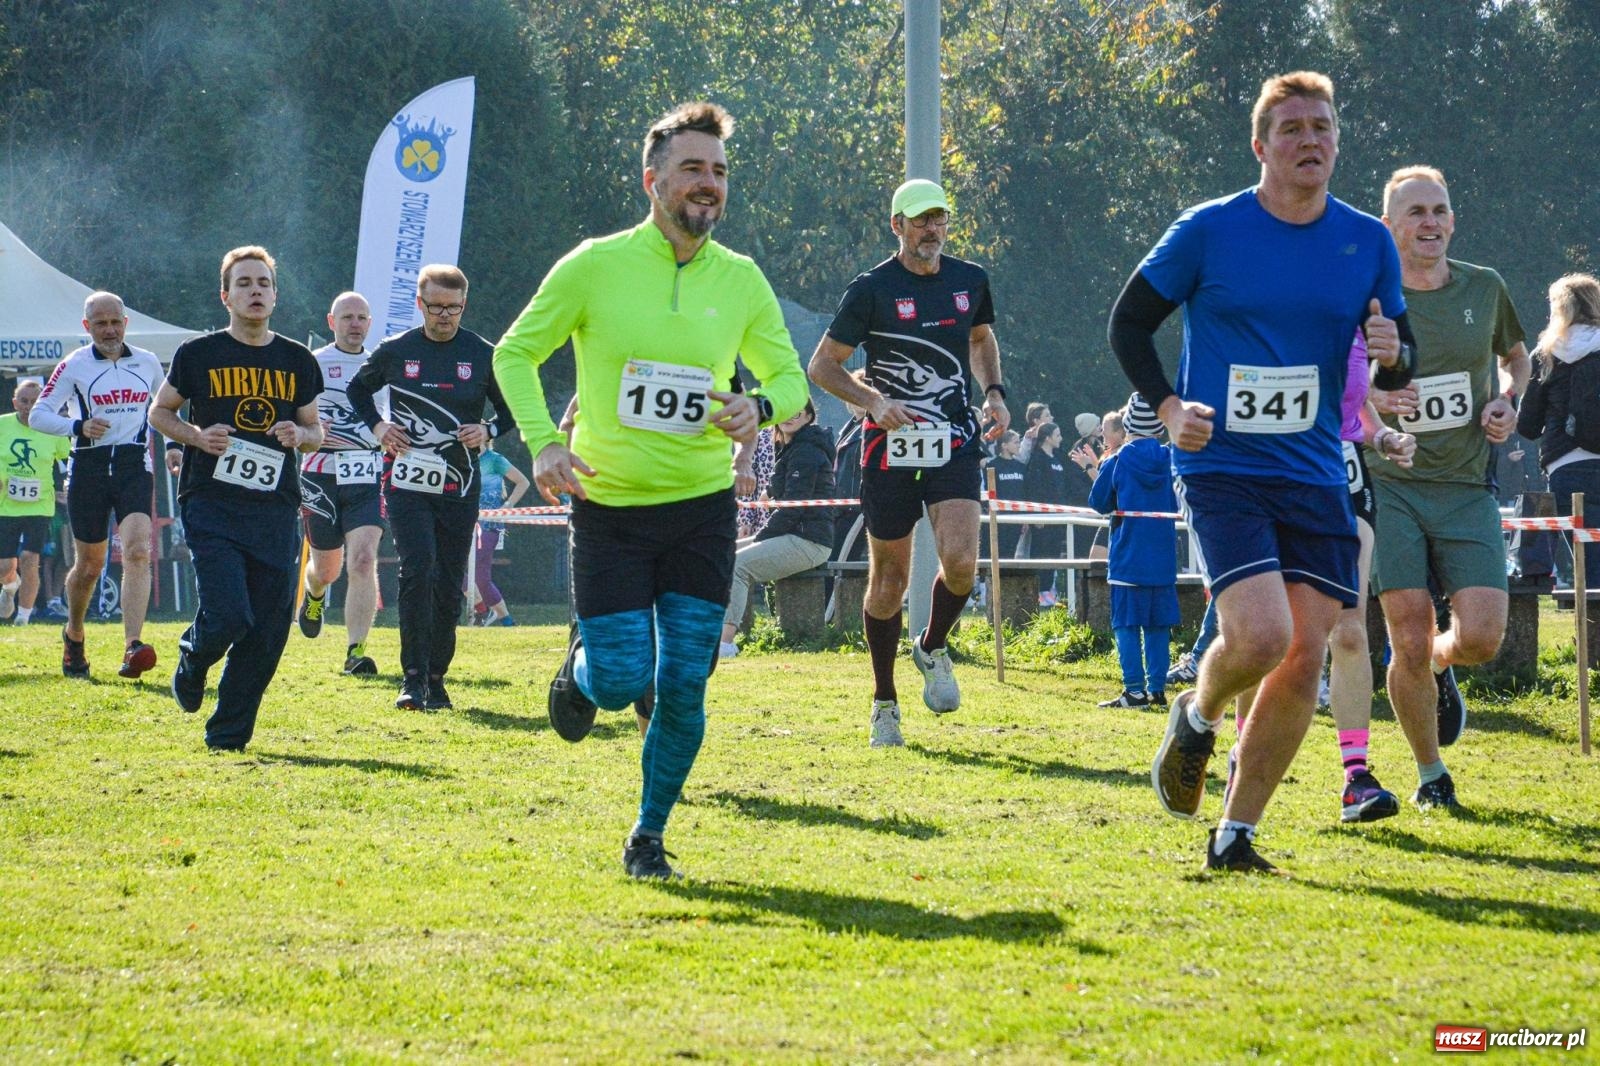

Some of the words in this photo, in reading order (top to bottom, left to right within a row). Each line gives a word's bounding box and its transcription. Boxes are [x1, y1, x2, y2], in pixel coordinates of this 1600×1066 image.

[394, 190, 430, 275] STOWARZYSZENIE
[387, 276, 418, 321] AKTYWNI
[208, 366, 296, 402] NIRVANA
[627, 385, 706, 422] 195
[1234, 390, 1310, 420] 341
[892, 438, 944, 459] 311
[223, 454, 276, 486] 193
[339, 461, 375, 478] 324
[394, 463, 442, 488] 320
[9, 484, 38, 497] 315
